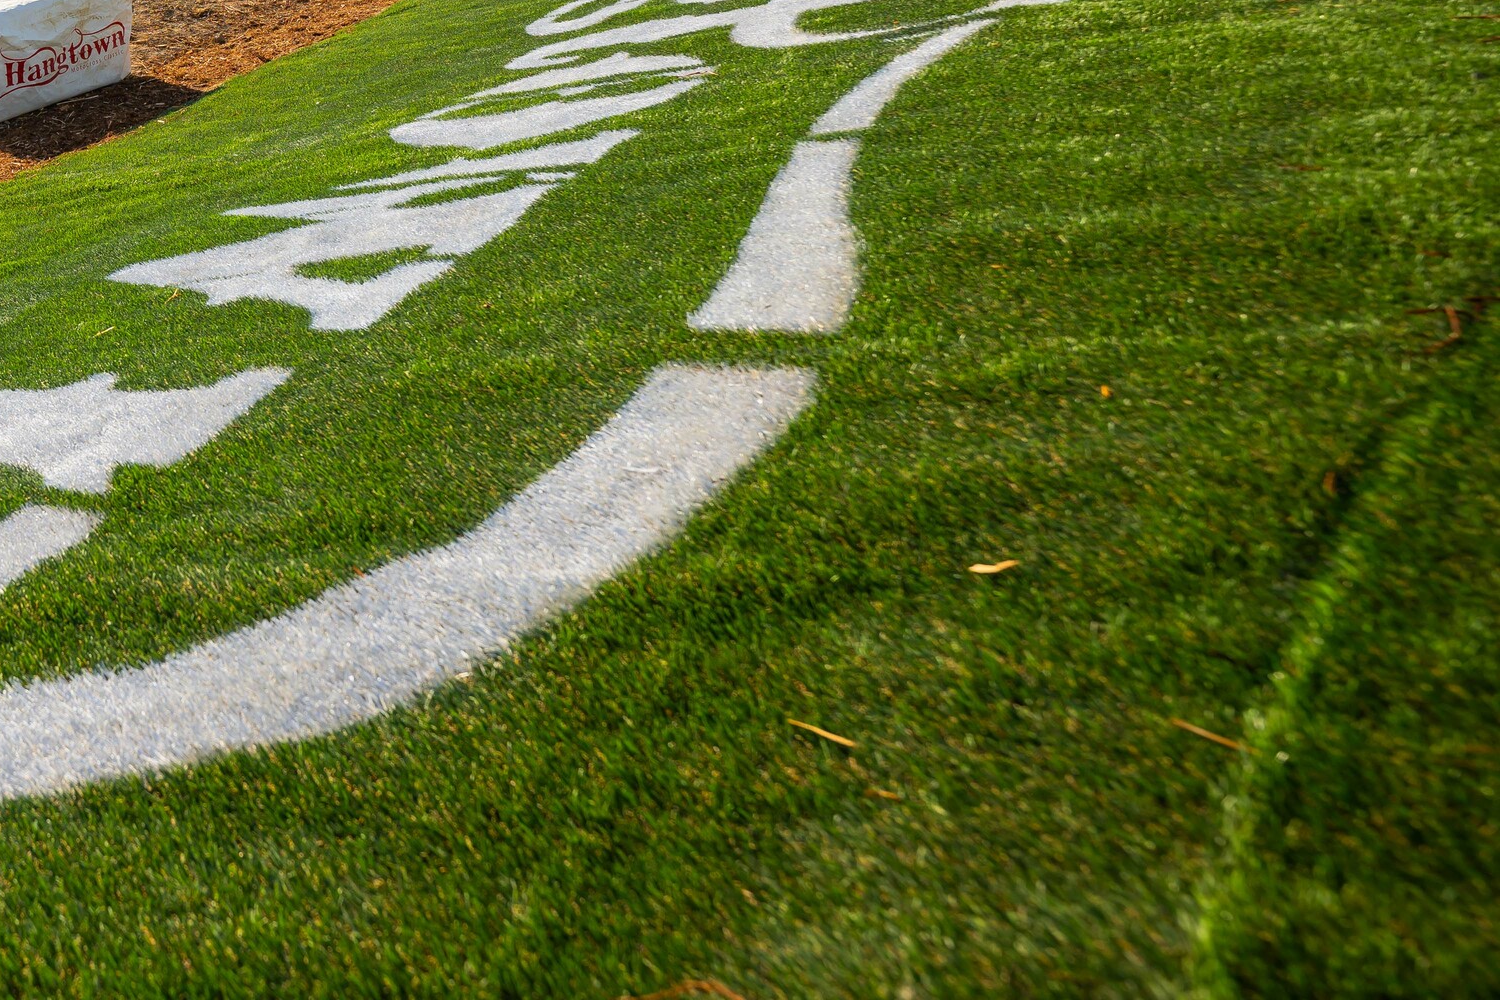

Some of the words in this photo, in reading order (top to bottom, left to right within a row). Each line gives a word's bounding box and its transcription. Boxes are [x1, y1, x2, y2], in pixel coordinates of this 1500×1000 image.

[0, 22, 126, 95] Hangtown
[70, 58, 103, 74] Motocross
[103, 48, 125, 61] Classic
